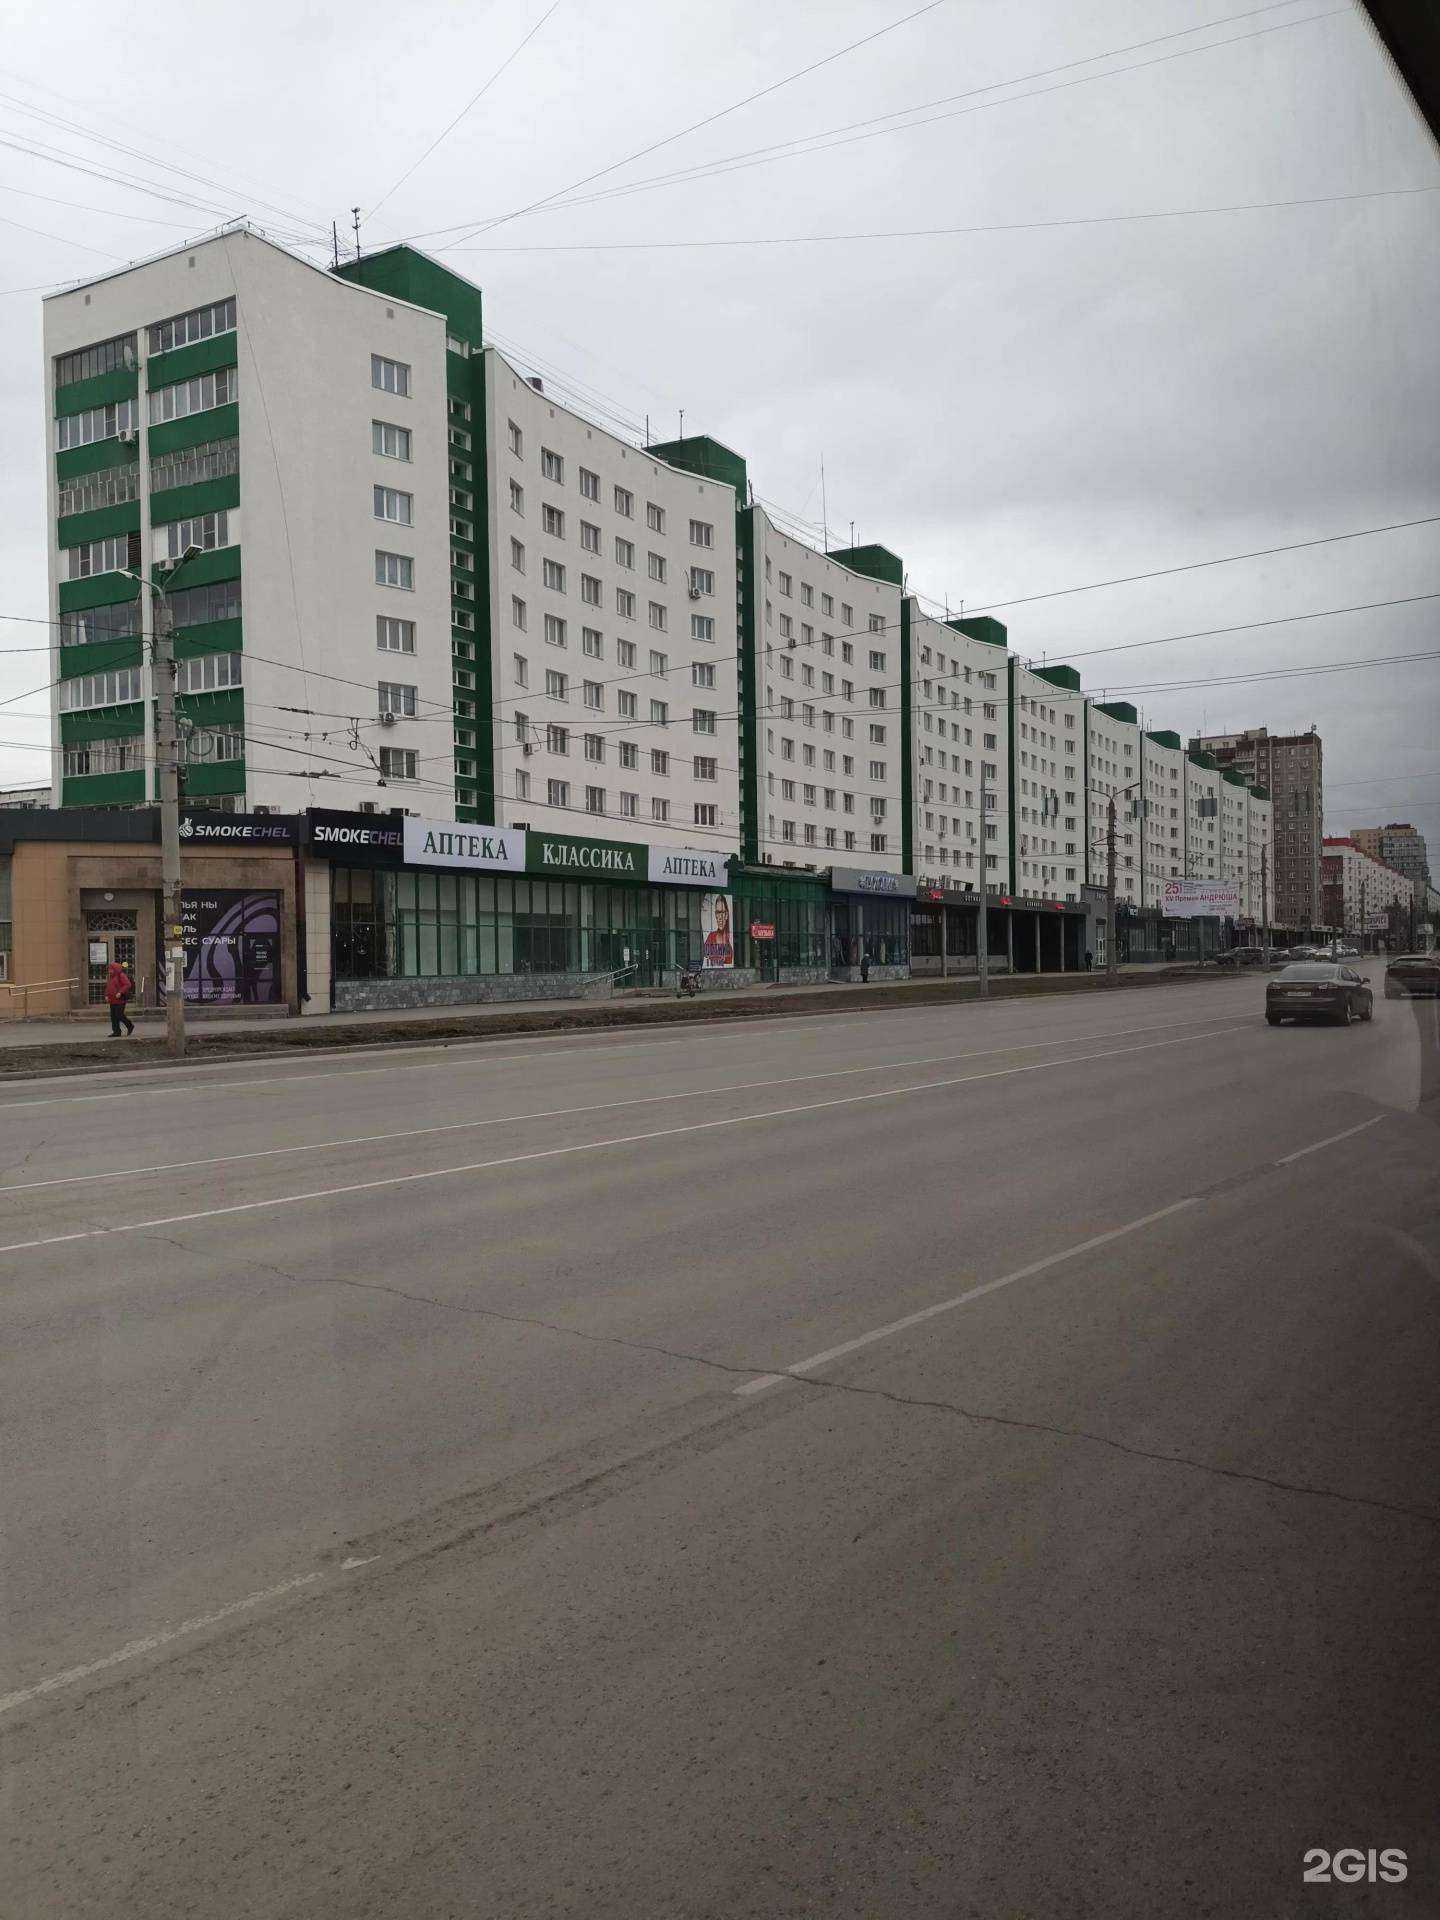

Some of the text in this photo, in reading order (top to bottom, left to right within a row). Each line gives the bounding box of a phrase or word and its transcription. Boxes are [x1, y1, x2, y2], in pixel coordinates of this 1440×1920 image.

[194, 824, 290, 838] SMOKECHEL
[313, 825, 403, 847] SMOKECHEL
[422, 830, 508, 861] АПТЕКА
[542, 843, 635, 871] КЛАССИКА
[662, 856, 716, 878] АПТЕКА
